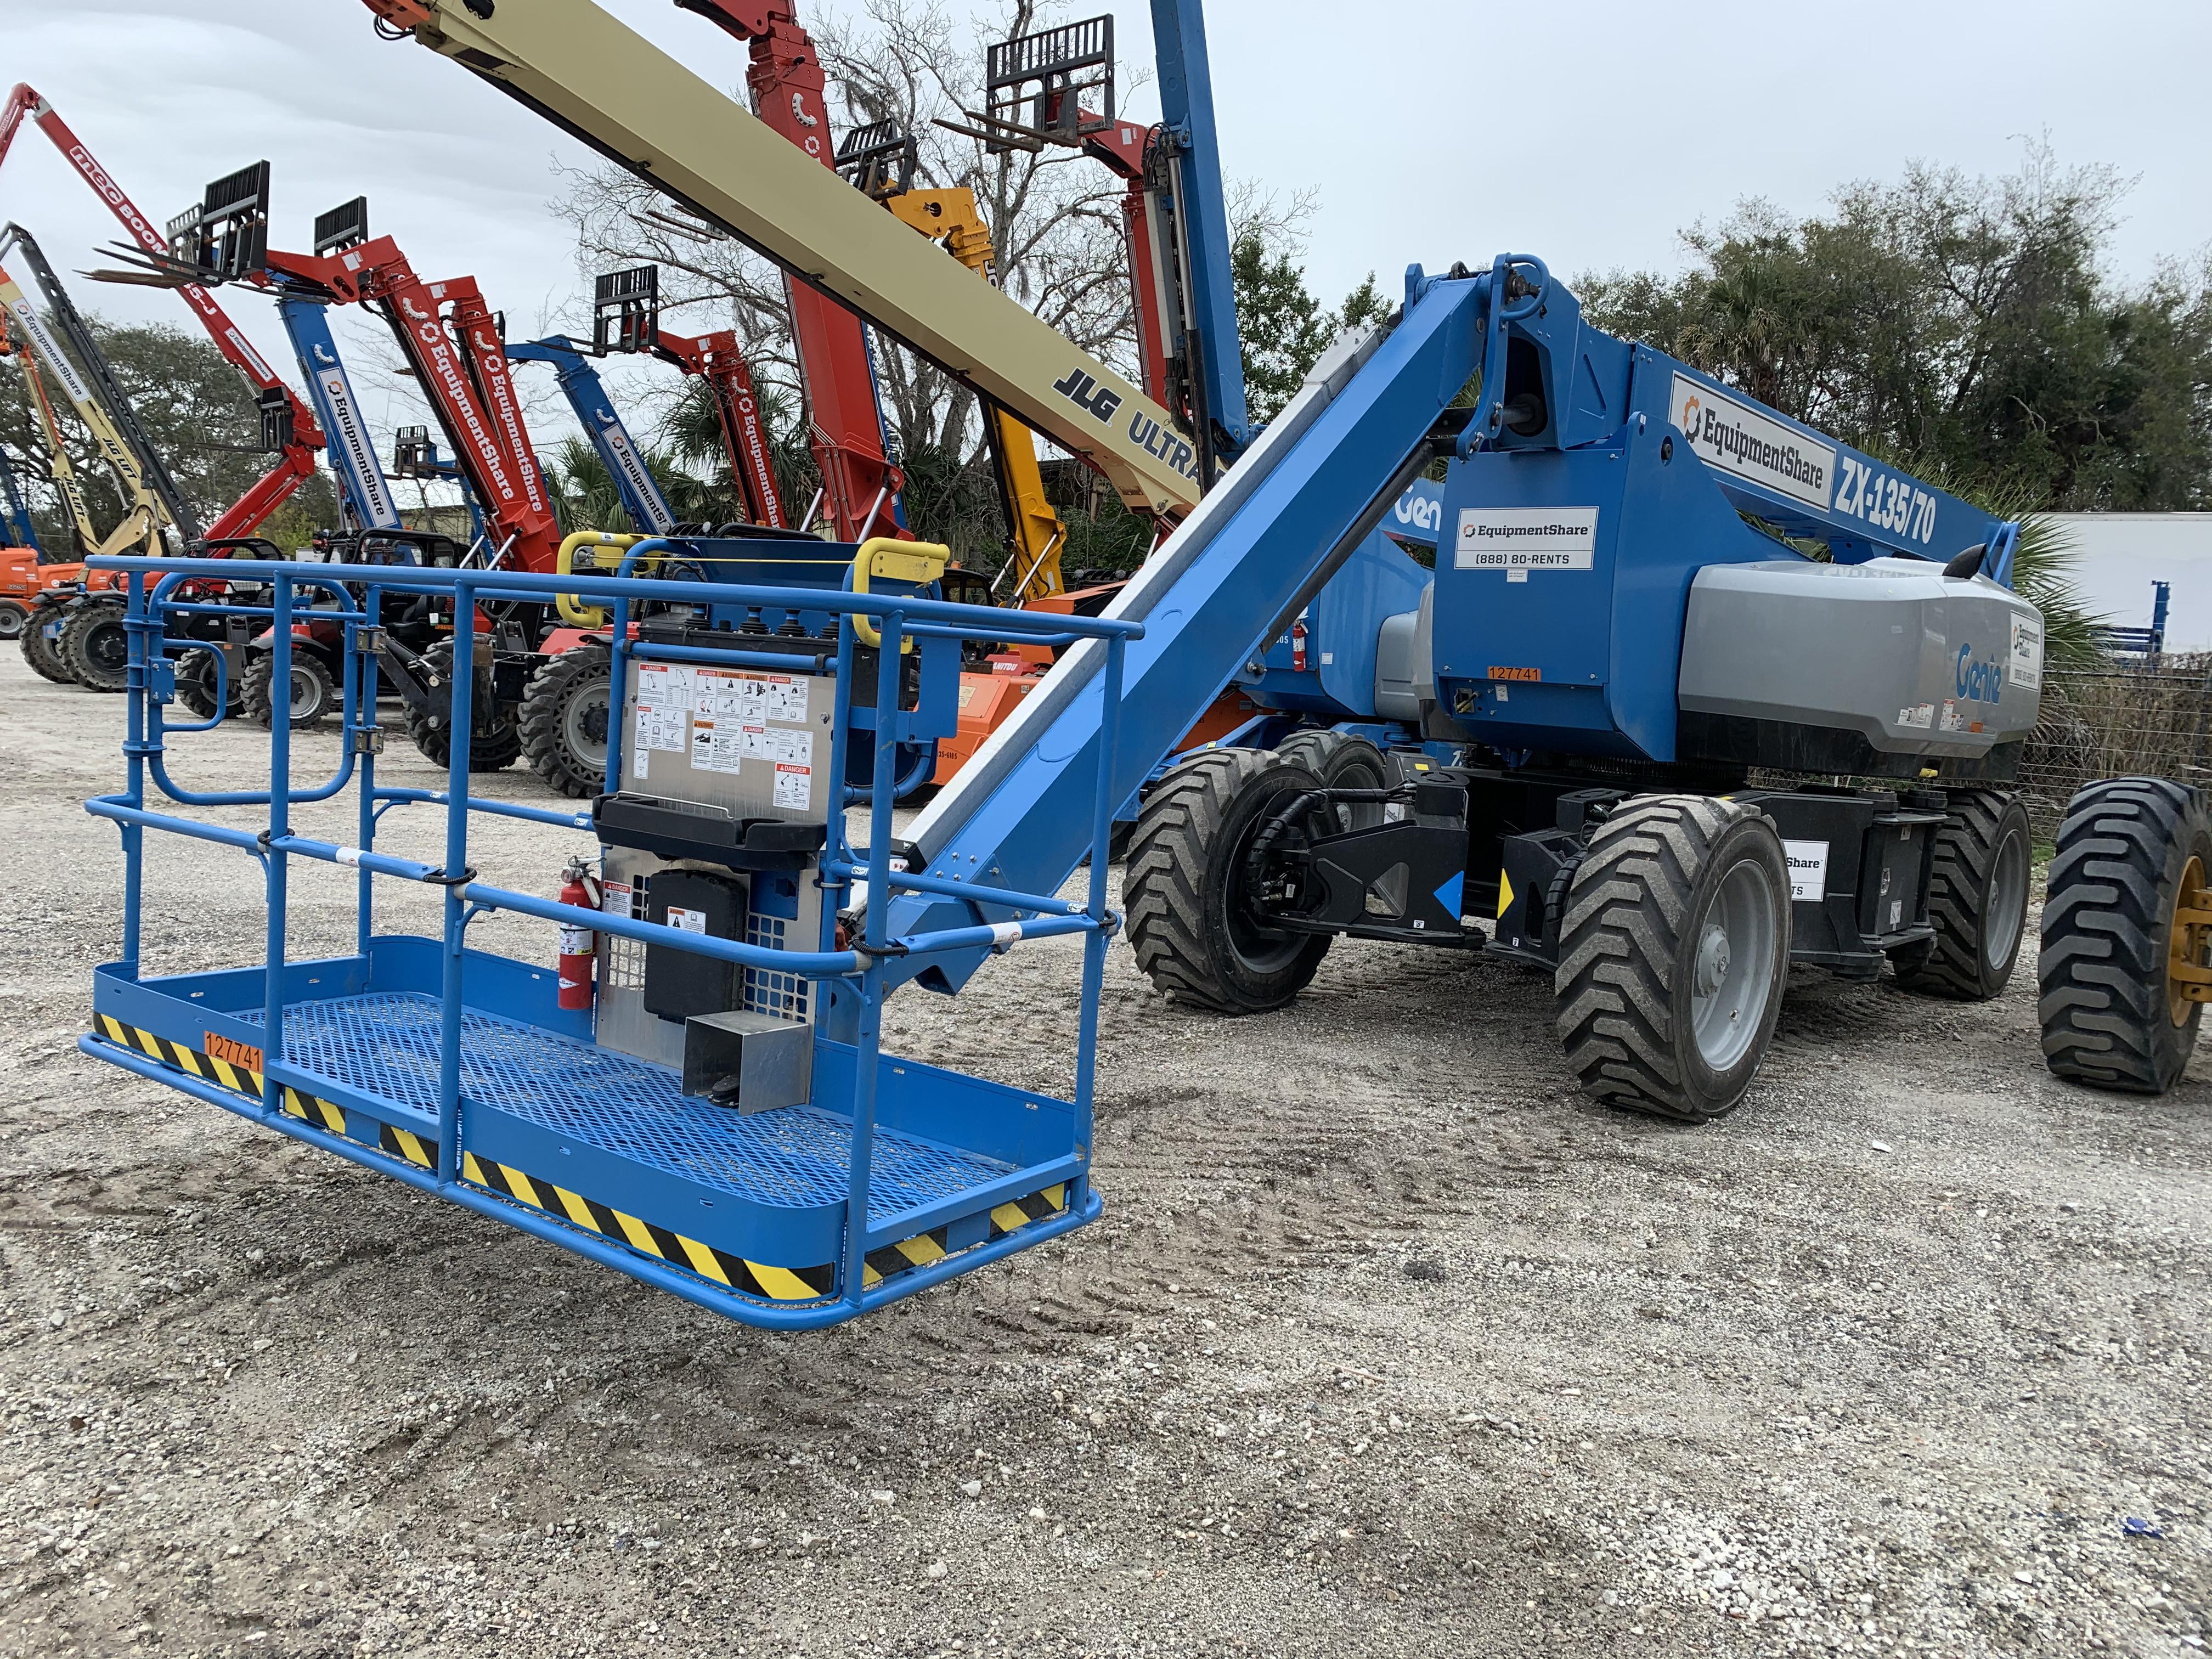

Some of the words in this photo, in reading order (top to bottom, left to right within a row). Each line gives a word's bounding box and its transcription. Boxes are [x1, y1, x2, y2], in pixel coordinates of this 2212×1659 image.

[25, 317, 82, 396] EquipmentShare
[234, 336, 269, 378] EquipmentShare
[1053, 367, 1124, 425] JLG
[431, 343, 514, 500] EquipmentShare
[490, 375, 543, 512] EquipmentShare
[103, 438, 120, 455] JLG
[116, 458, 137, 479] LIFT
[335, 398, 385, 516] EquipmentShare
[1703, 407, 1824, 490] EquipmentShare
[1834, 456, 1937, 544] ZX-135/70
[64, 477, 77, 493] JLG
[71, 496, 85, 516] LIFT
[620, 449, 668, 525] EquipmentS
[1395, 484, 1442, 532] Gen
[1478, 524, 1588, 538] EquipmentShare
[1476, 554, 1508, 565] (888)
[1511, 554, 1570, 565] 80-RENTS
[992, 662, 1018, 671] ANITOU
[1489, 667, 1538, 681] 127741
[1956, 642, 2002, 706] Genie
[784, 765, 806, 774] DANGER
[206, 1032, 260, 1073] 127741
